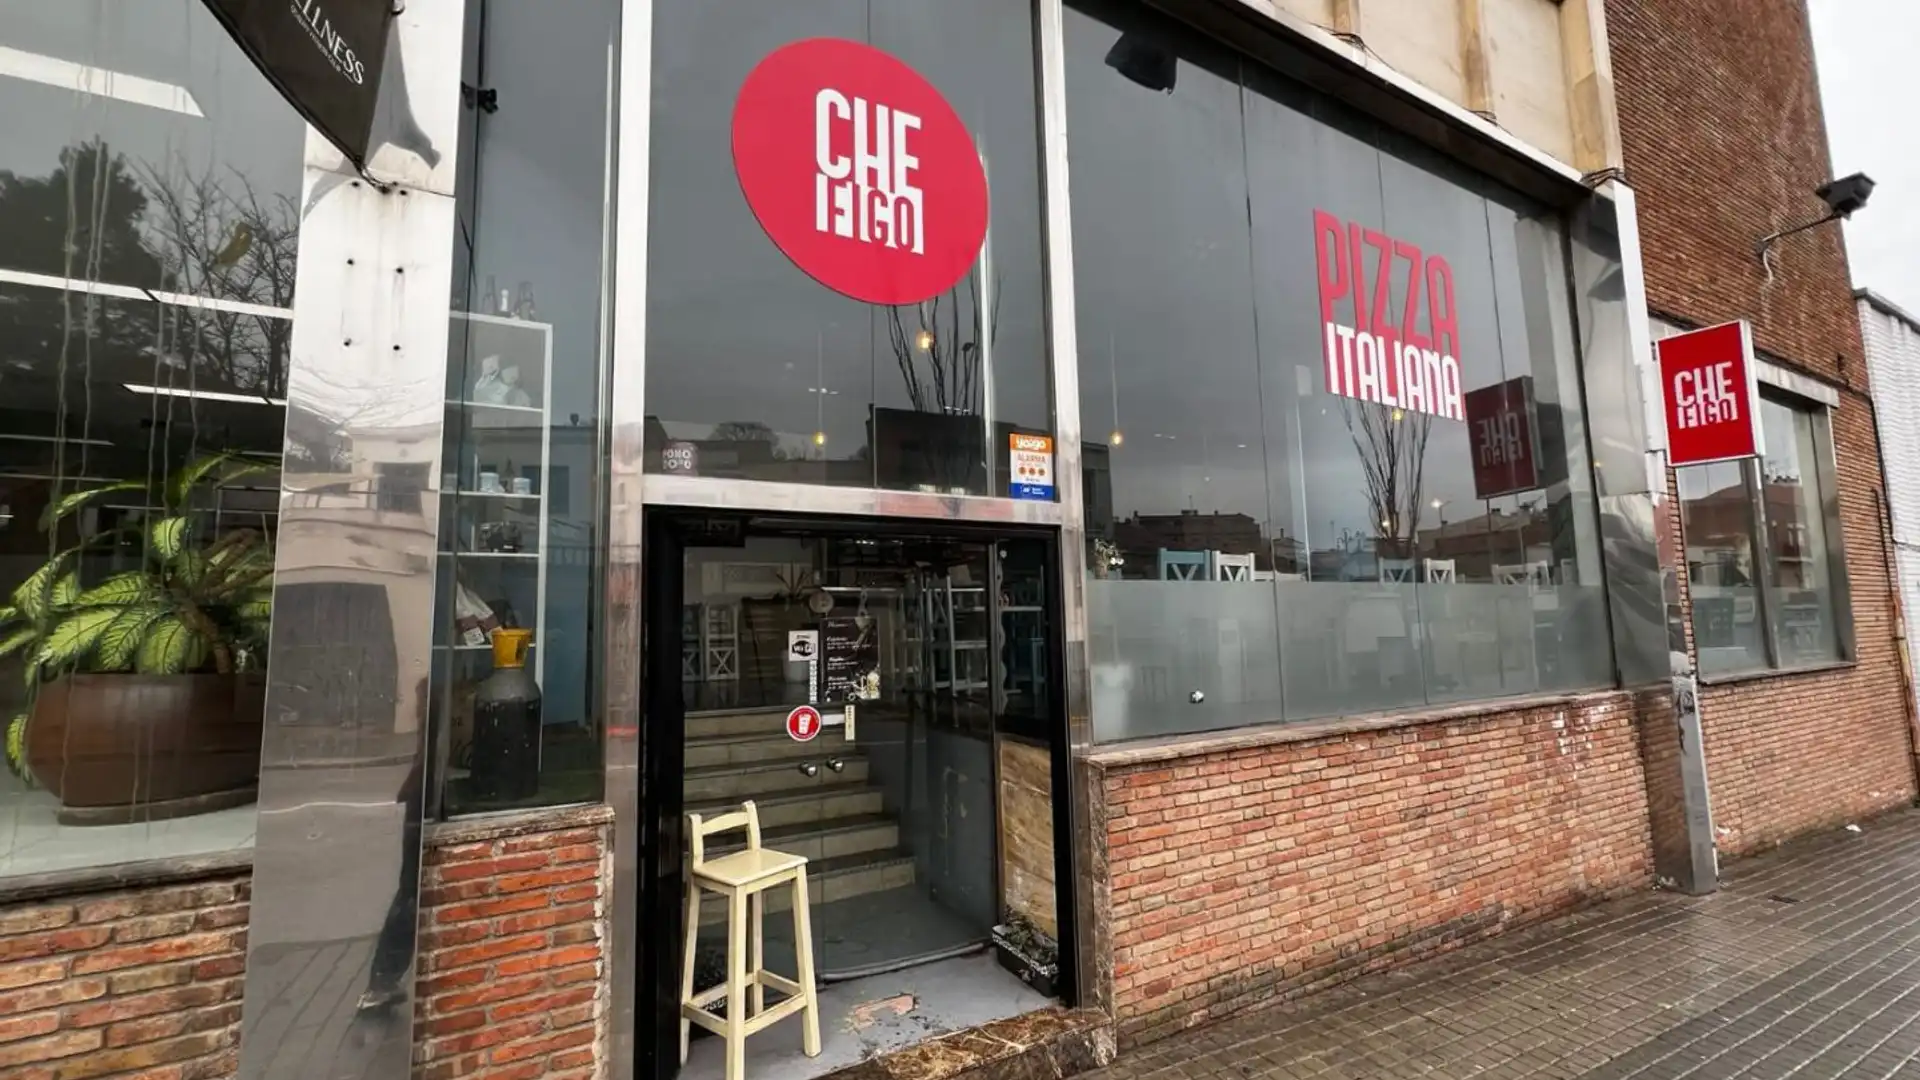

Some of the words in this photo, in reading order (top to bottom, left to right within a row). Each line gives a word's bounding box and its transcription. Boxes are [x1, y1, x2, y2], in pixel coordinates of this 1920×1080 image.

[294, 0, 365, 85] LLNESS
[816, 88, 922, 194] CHE
[1313, 207, 1464, 412] PIZZA
[1326, 322, 1464, 421] ITALIANA
[1674, 361, 1733, 407] CHE
